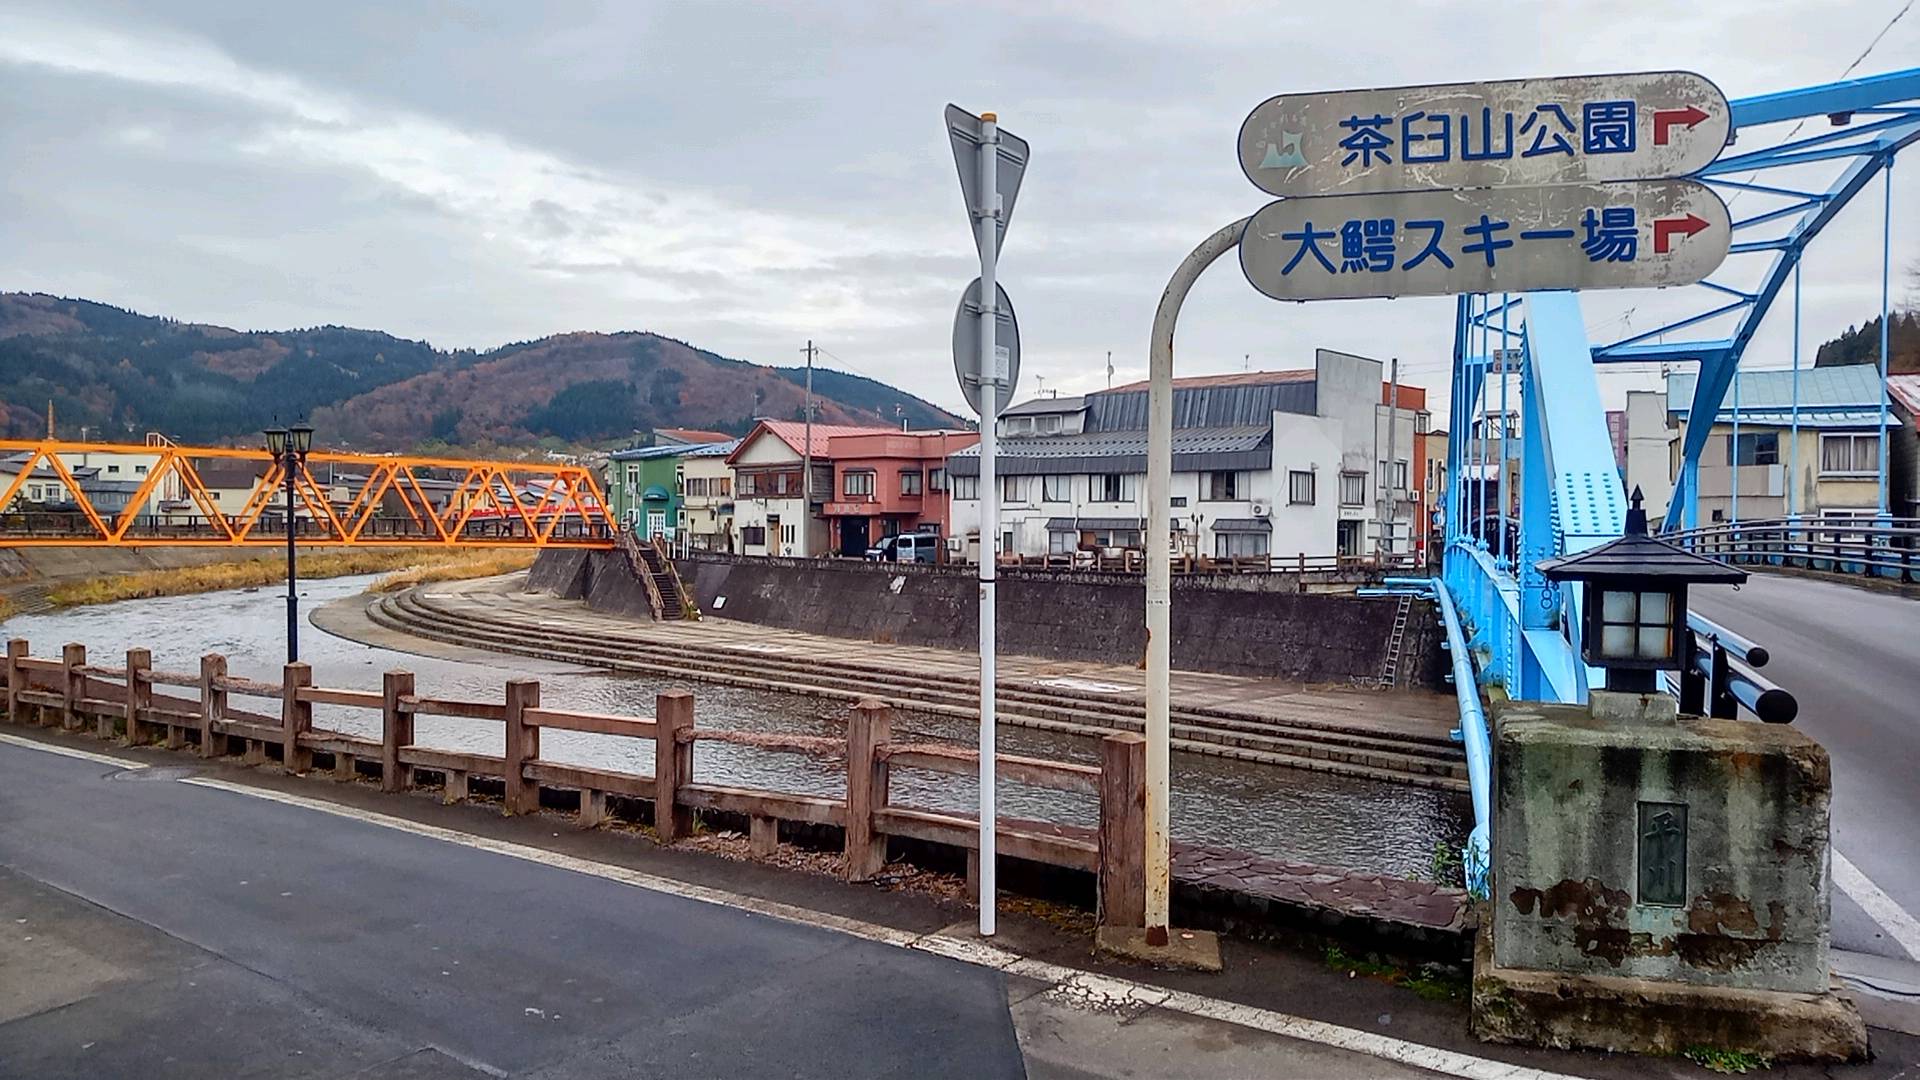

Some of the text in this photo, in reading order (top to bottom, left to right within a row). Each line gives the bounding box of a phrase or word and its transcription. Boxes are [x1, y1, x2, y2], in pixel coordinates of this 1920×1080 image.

[1340, 101, 1636, 166] 茶臼山公園
[1281, 208, 1638, 274] 大鰐スキー場
